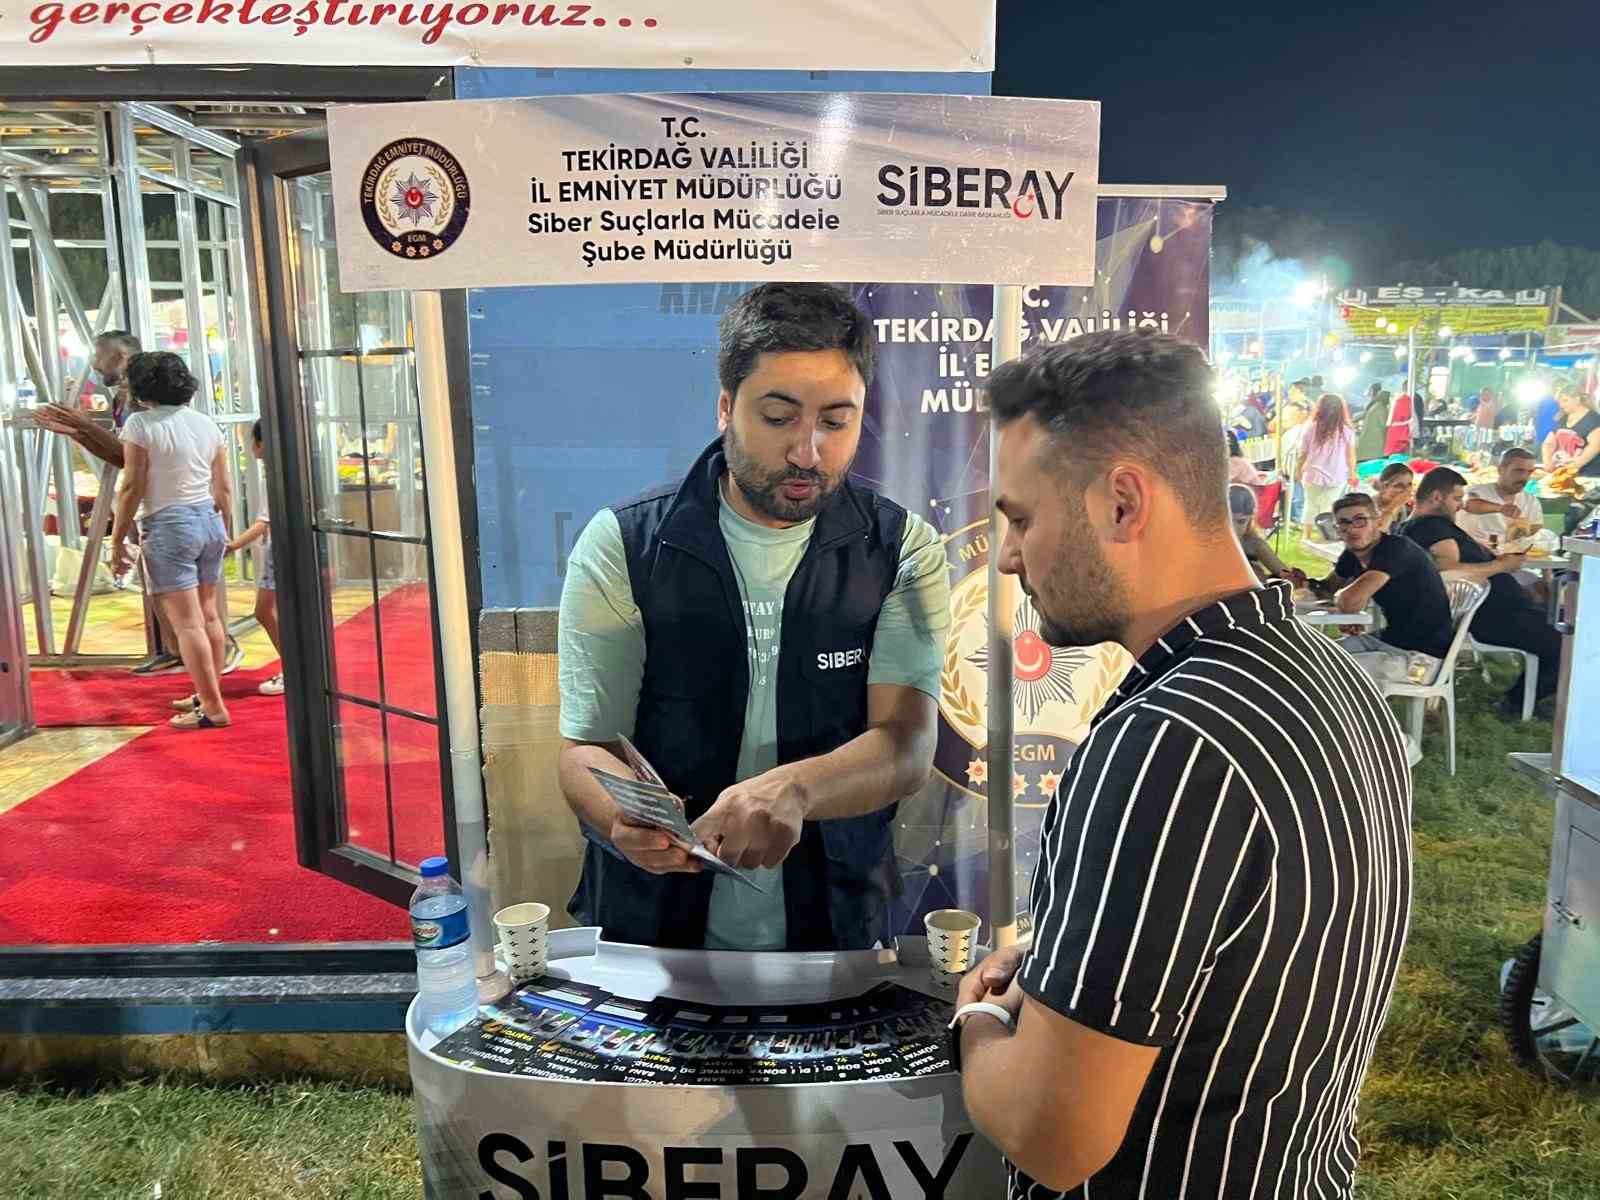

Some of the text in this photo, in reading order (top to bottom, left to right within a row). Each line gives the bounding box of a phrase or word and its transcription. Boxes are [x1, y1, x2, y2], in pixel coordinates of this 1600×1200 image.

[660, 116, 706, 138] T.C.
[561, 140, 808, 172] TEKİRDAĞ VALİLİĞİ
[363, 156, 386, 204] TEKİRDAĞ
[530, 172, 842, 204] İL EMNİYET MÜDÜRLÜĞÜ
[528, 208, 839, 236] Siber Suçlarla Mücadele
[581, 237, 793, 267] Şube Müdürlüğü
[938, 345, 964, 378] İL
[816, 648, 863, 670] SIBER
